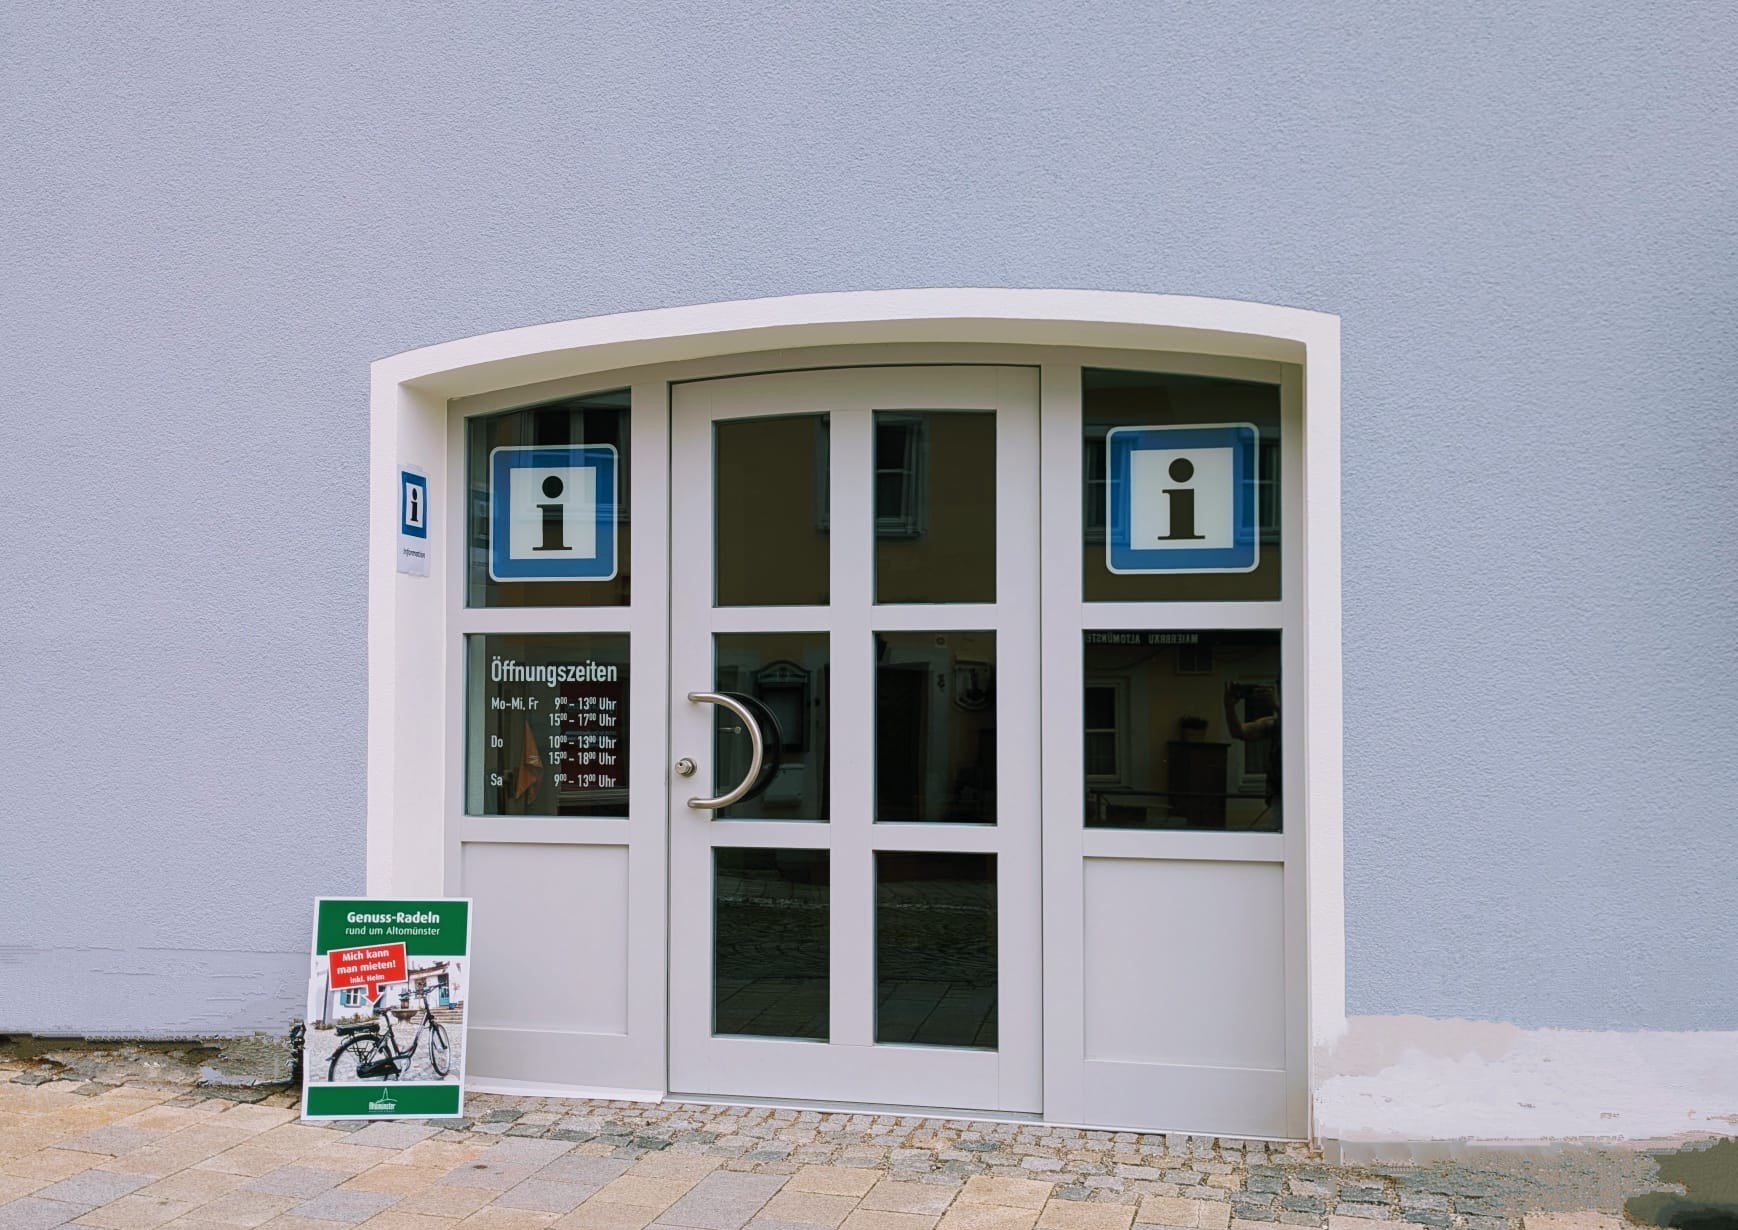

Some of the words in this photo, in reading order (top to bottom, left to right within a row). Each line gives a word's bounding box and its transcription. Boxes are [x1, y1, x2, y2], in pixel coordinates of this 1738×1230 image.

[491, 656, 617, 687] Öffnungszeiten
[528, 697, 539, 710] Fr
[599, 697, 617, 710] Uhr
[599, 713, 617, 726] Uhr
[491, 736, 504, 748] Do
[599, 735, 617, 748] Uhr
[599, 752, 617, 765] Uhr
[491, 773, 503, 786] Sa
[599, 774, 616, 787] Uhr
[347, 911, 440, 923] Genuss-Radeln
[345, 926, 366, 935] rund
[369, 927, 383, 935] um
[386, 926, 440, 935] Altomünster
[342, 951, 363, 961] Mich
[366, 949, 389, 959] kann
[337, 965, 358, 975] man
[360, 960, 396, 972] mieten!
[350, 975, 365, 983] inkl.
[367, 974, 385, 982] Helm
